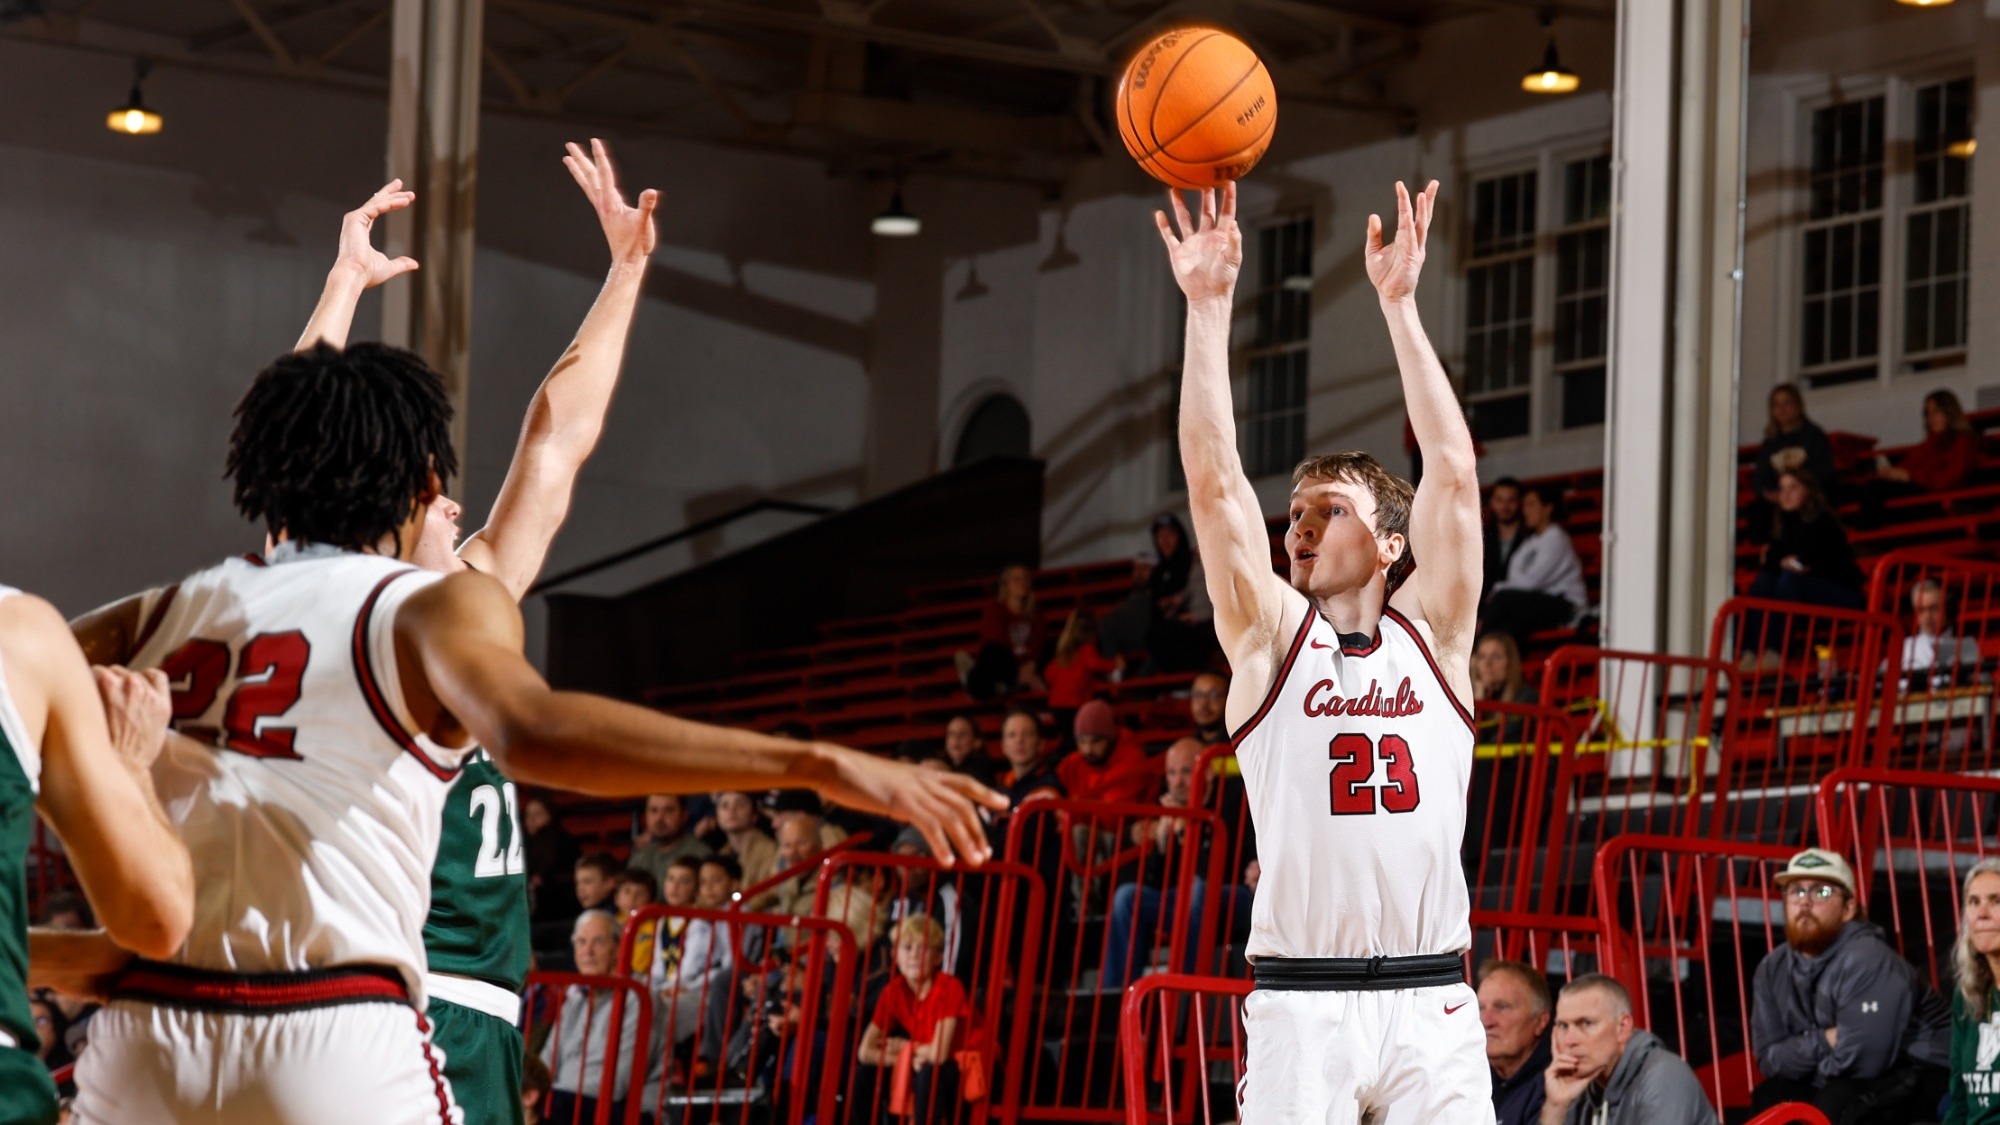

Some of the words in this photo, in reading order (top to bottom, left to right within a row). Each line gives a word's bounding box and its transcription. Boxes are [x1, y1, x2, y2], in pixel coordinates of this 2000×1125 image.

[160, 630, 310, 761] 22
[1304, 676, 1424, 718] Cardials
[1329, 733, 1420, 815] 23
[469, 782, 524, 878] 22
